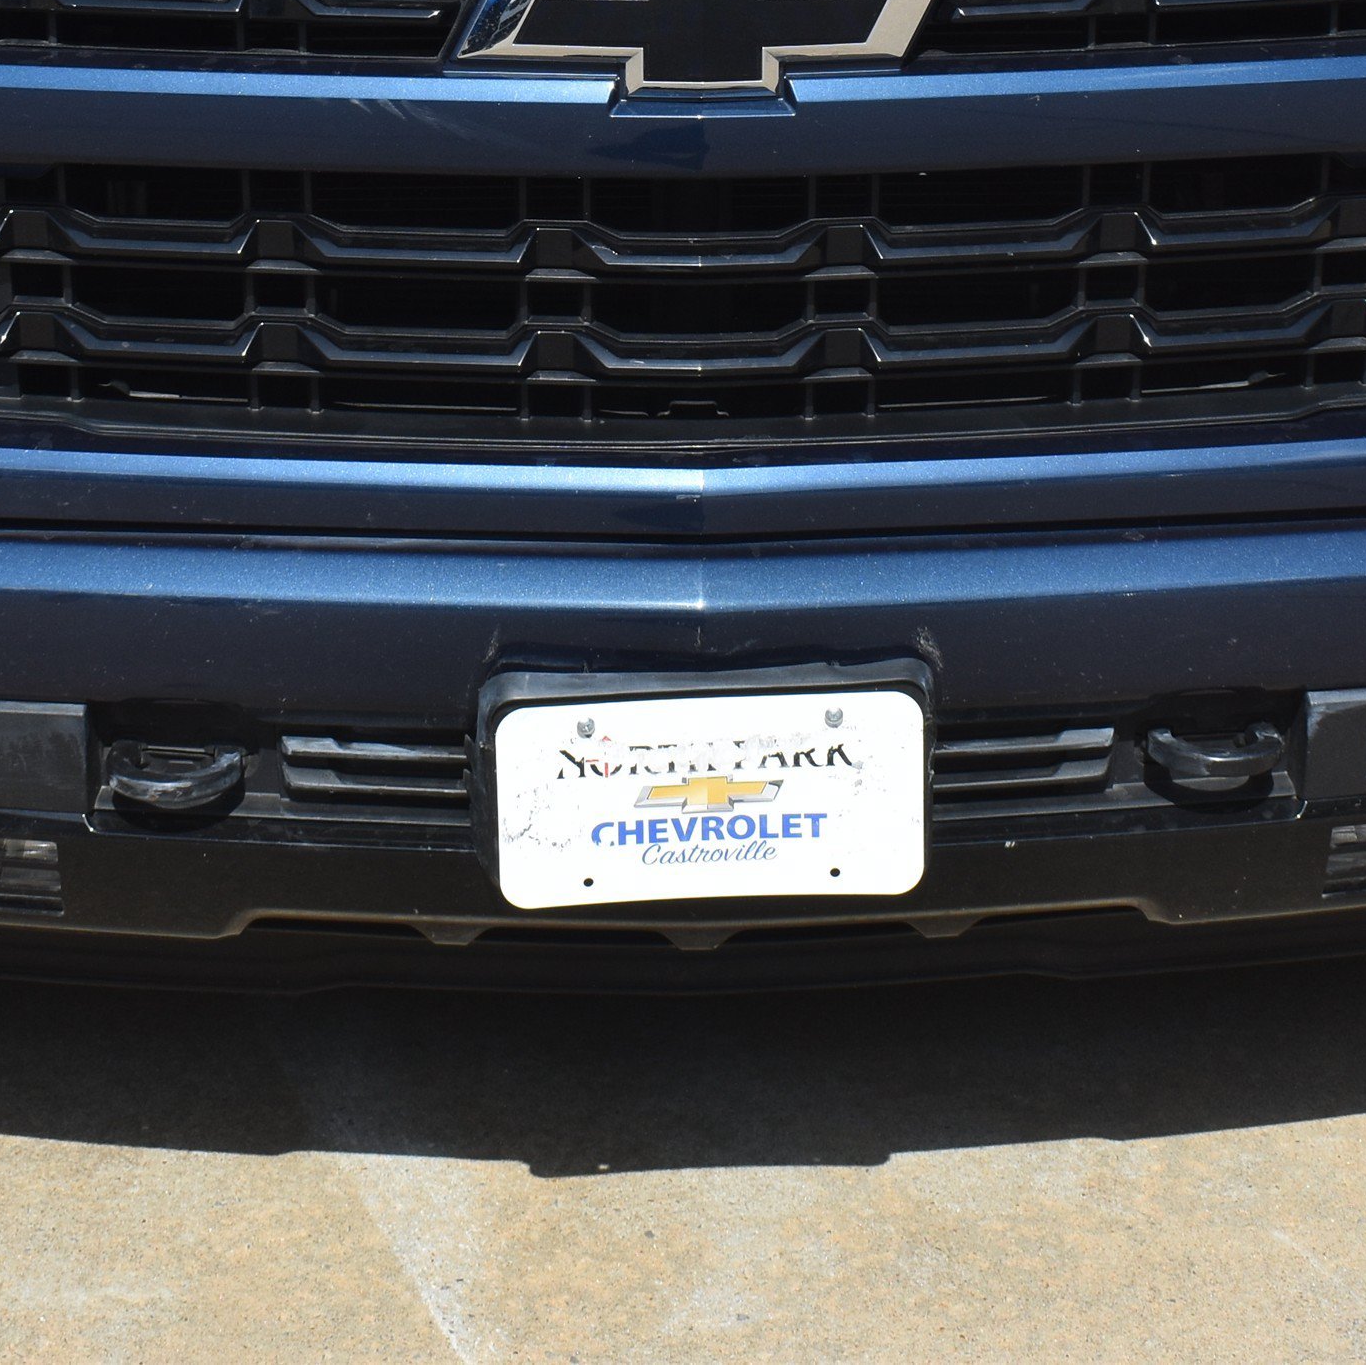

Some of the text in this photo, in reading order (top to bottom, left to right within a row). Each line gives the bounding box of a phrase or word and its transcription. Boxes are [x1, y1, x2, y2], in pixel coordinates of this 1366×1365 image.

[557, 739, 857, 779] NORT ARK
[591, 813, 827, 846] CHEVROLET
[642, 840, 777, 865] Castroville
